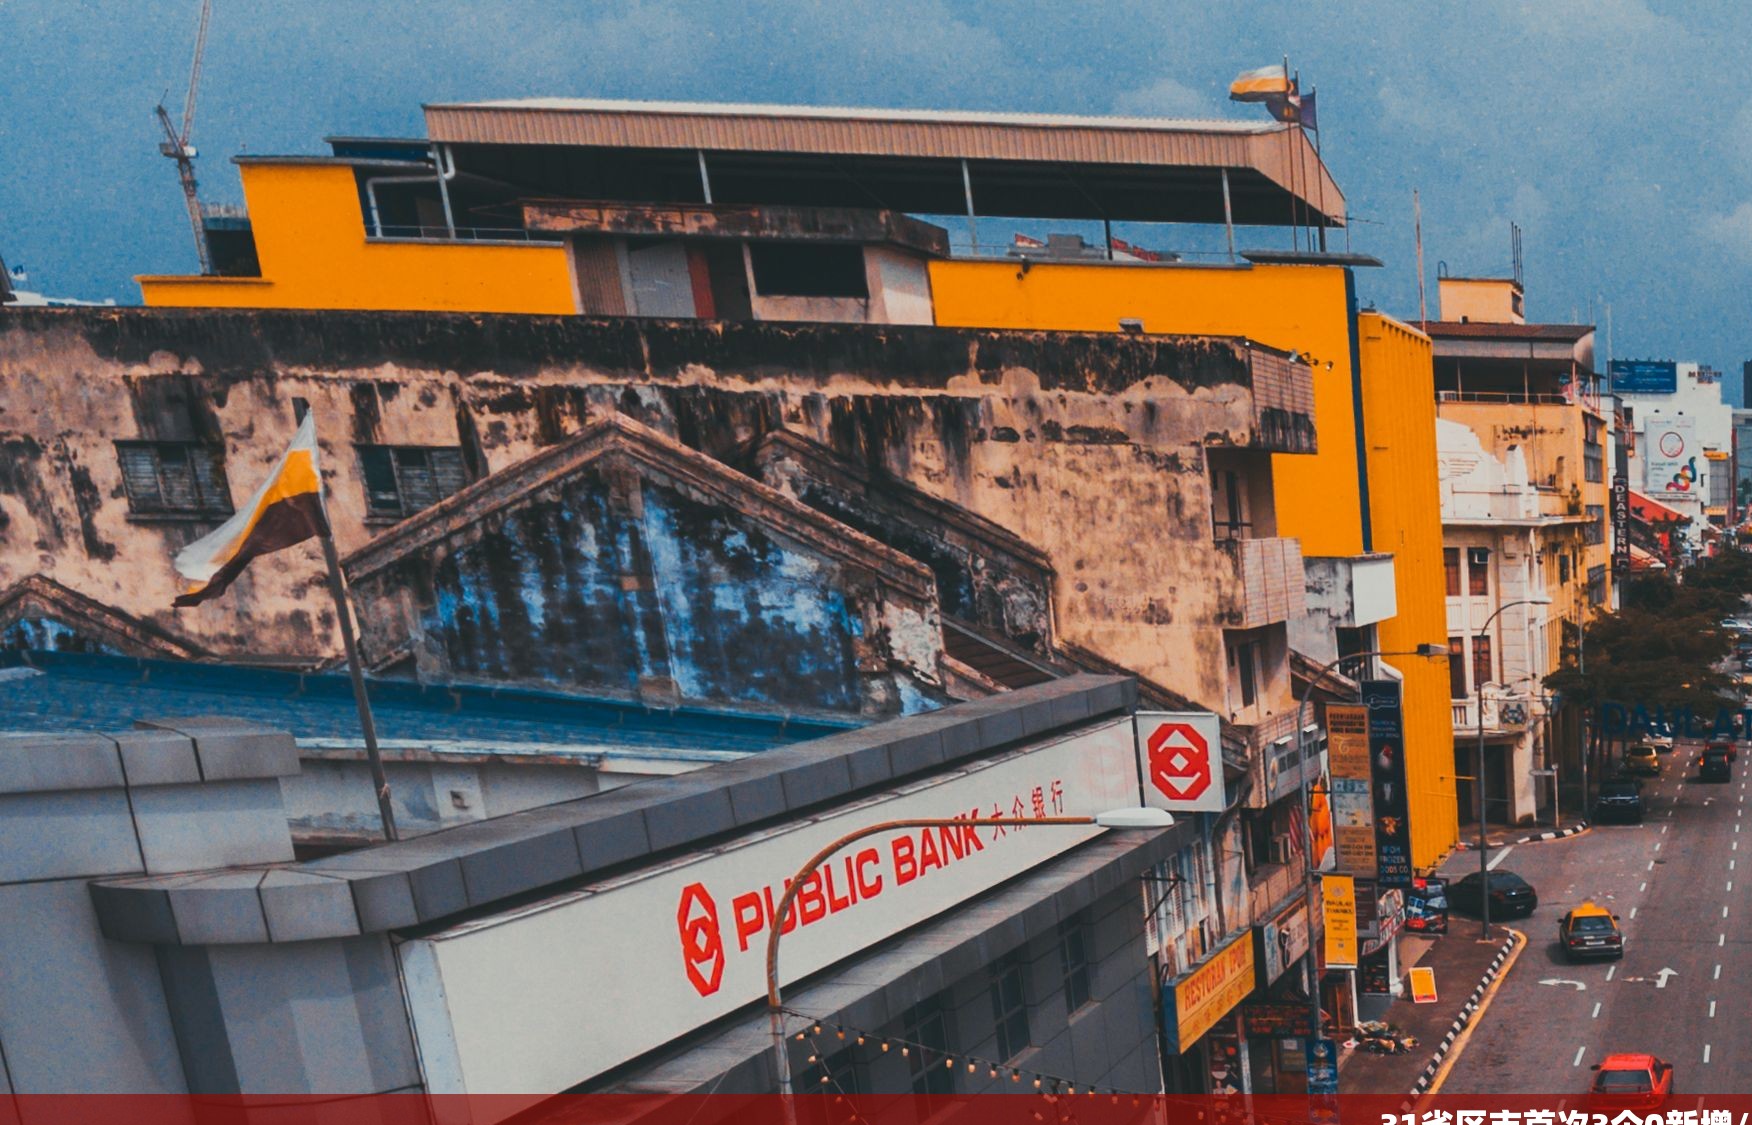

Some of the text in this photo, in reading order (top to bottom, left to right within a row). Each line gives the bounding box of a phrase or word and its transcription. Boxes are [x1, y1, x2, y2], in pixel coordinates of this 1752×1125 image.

[732, 808, 985, 953] PUBLIC BANK
[1184, 957, 1226, 1012] RESTORAN
